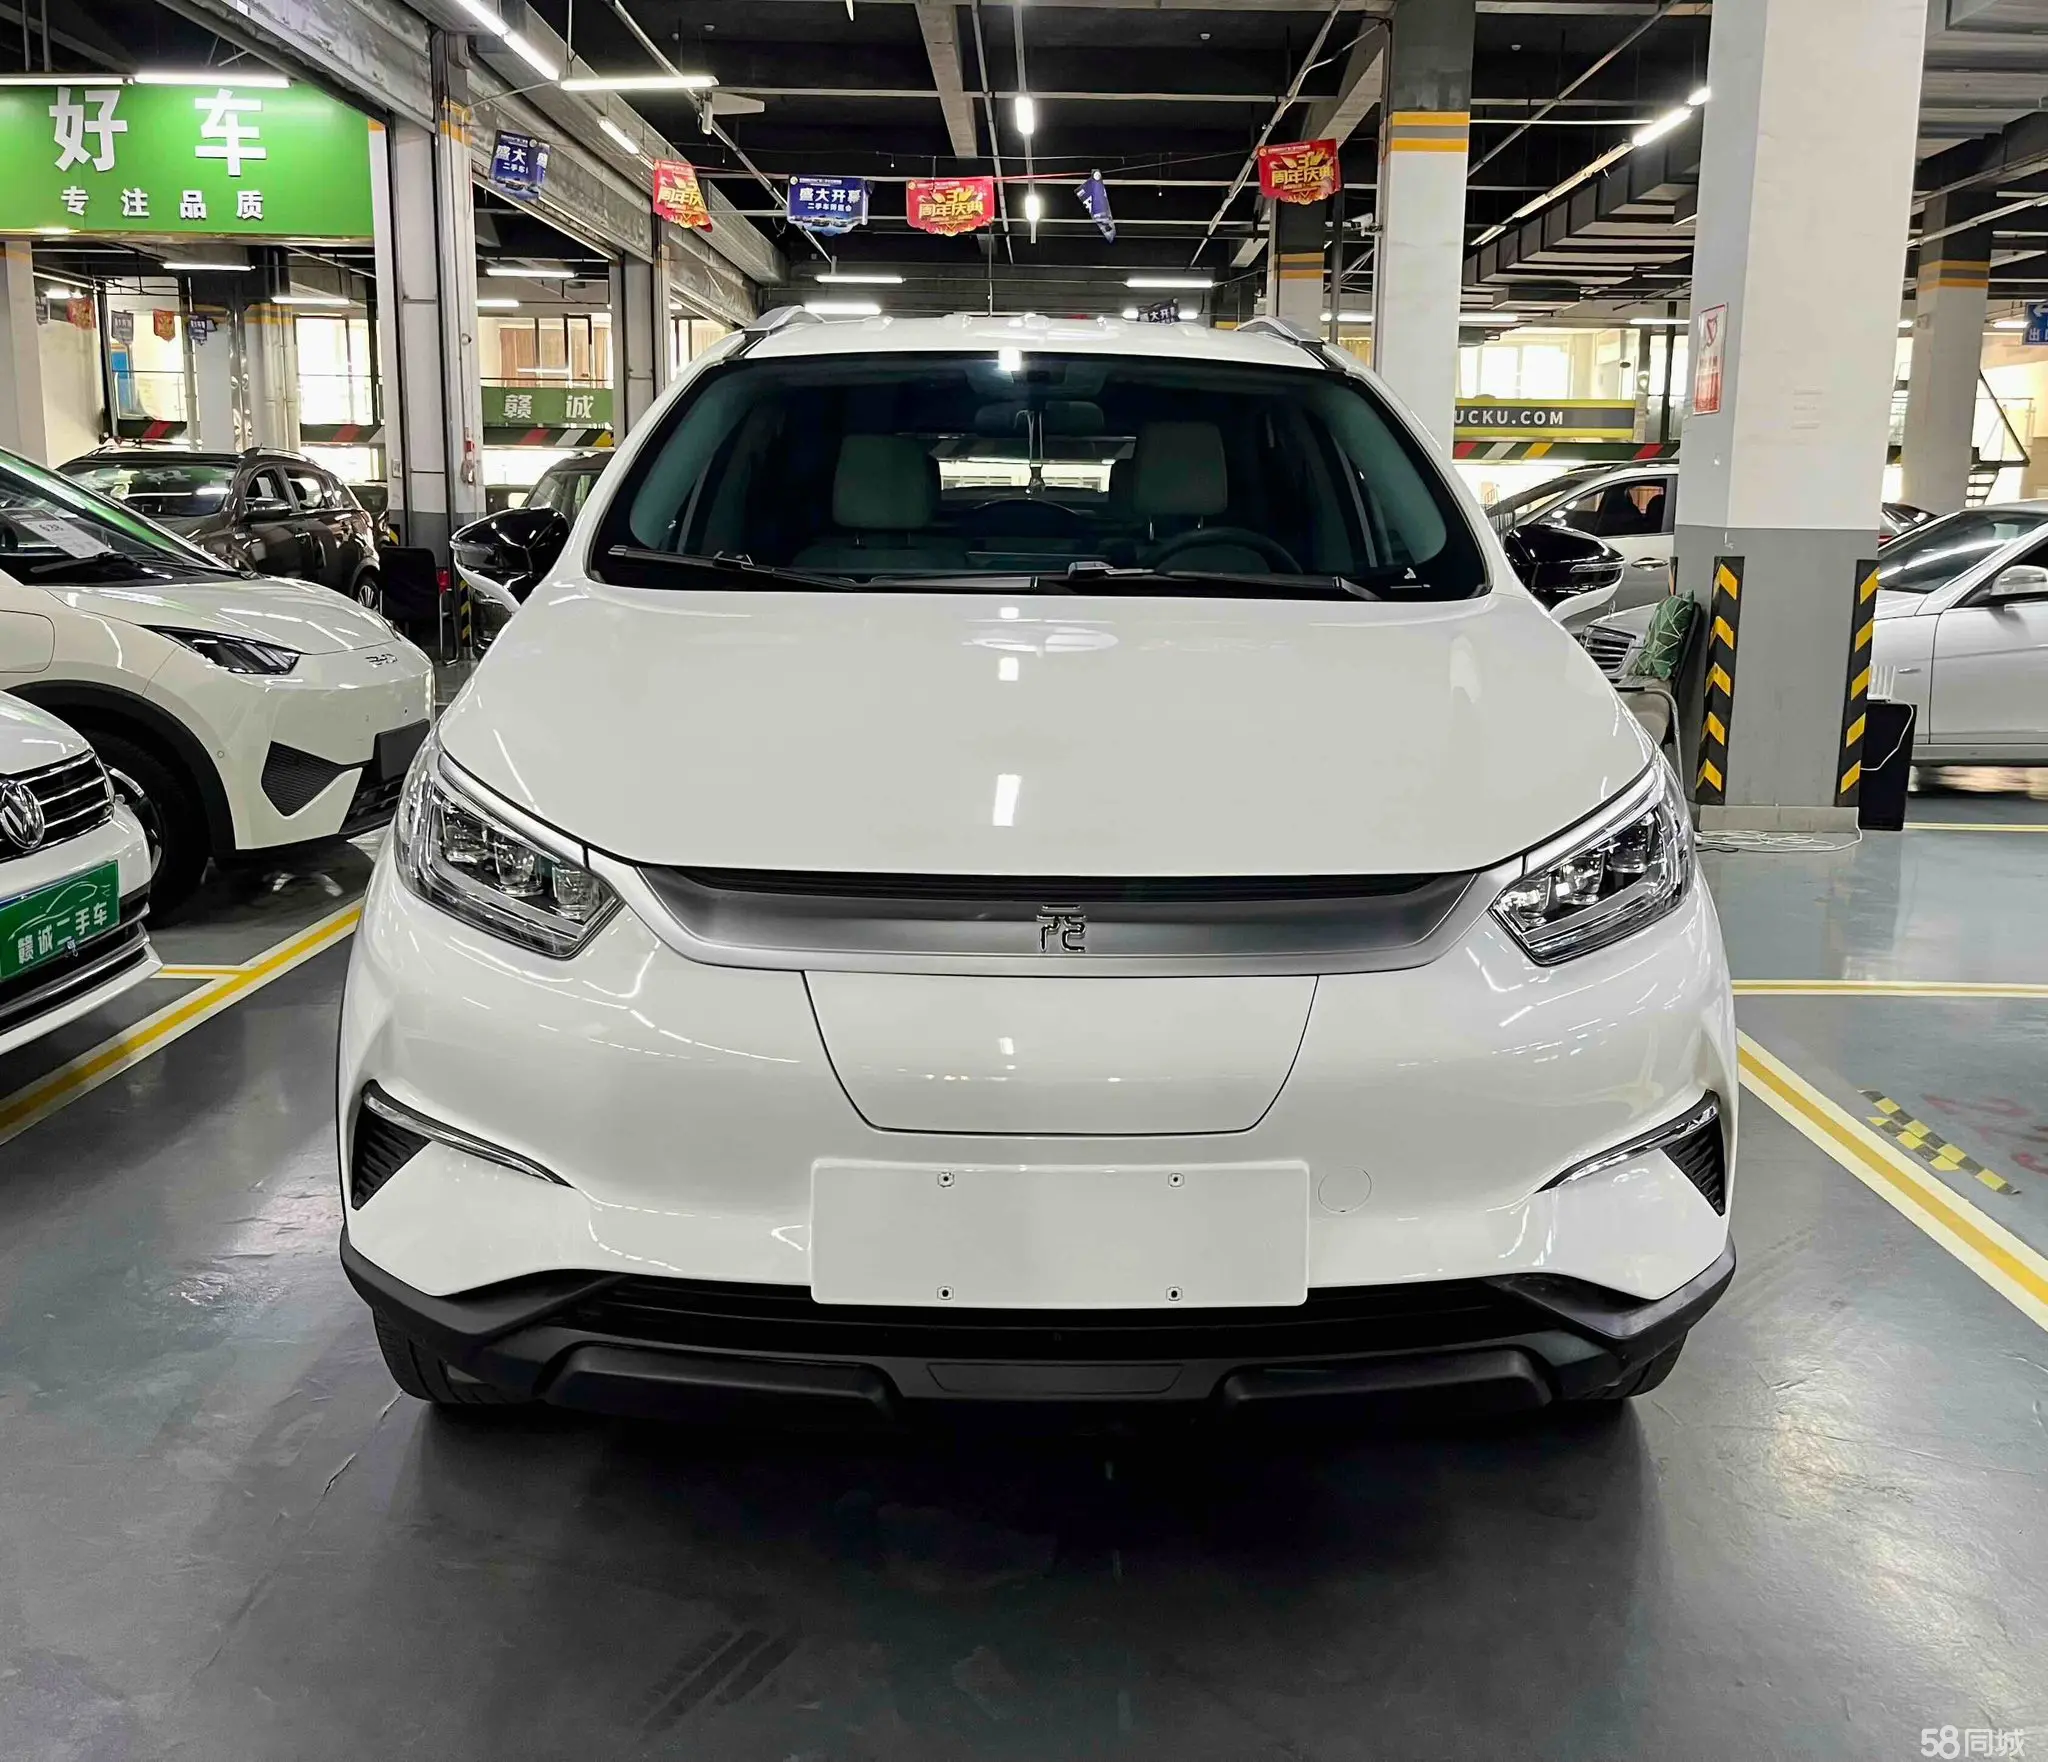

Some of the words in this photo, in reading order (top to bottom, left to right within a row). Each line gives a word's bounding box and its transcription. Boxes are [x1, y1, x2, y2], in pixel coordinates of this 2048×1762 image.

[49, 87, 267, 176] 好车
[503, 162, 529, 175] 二手车
[1271, 165, 1334, 188] 周年庆典
[61, 186, 264, 220] 专注品质
[800, 187, 861, 203] 盛大开幕
[919, 200, 984, 219] 周年庆典
[503, 394, 594, 419] 赣诚
[17, 901, 108, 964] 赣诚二手车
